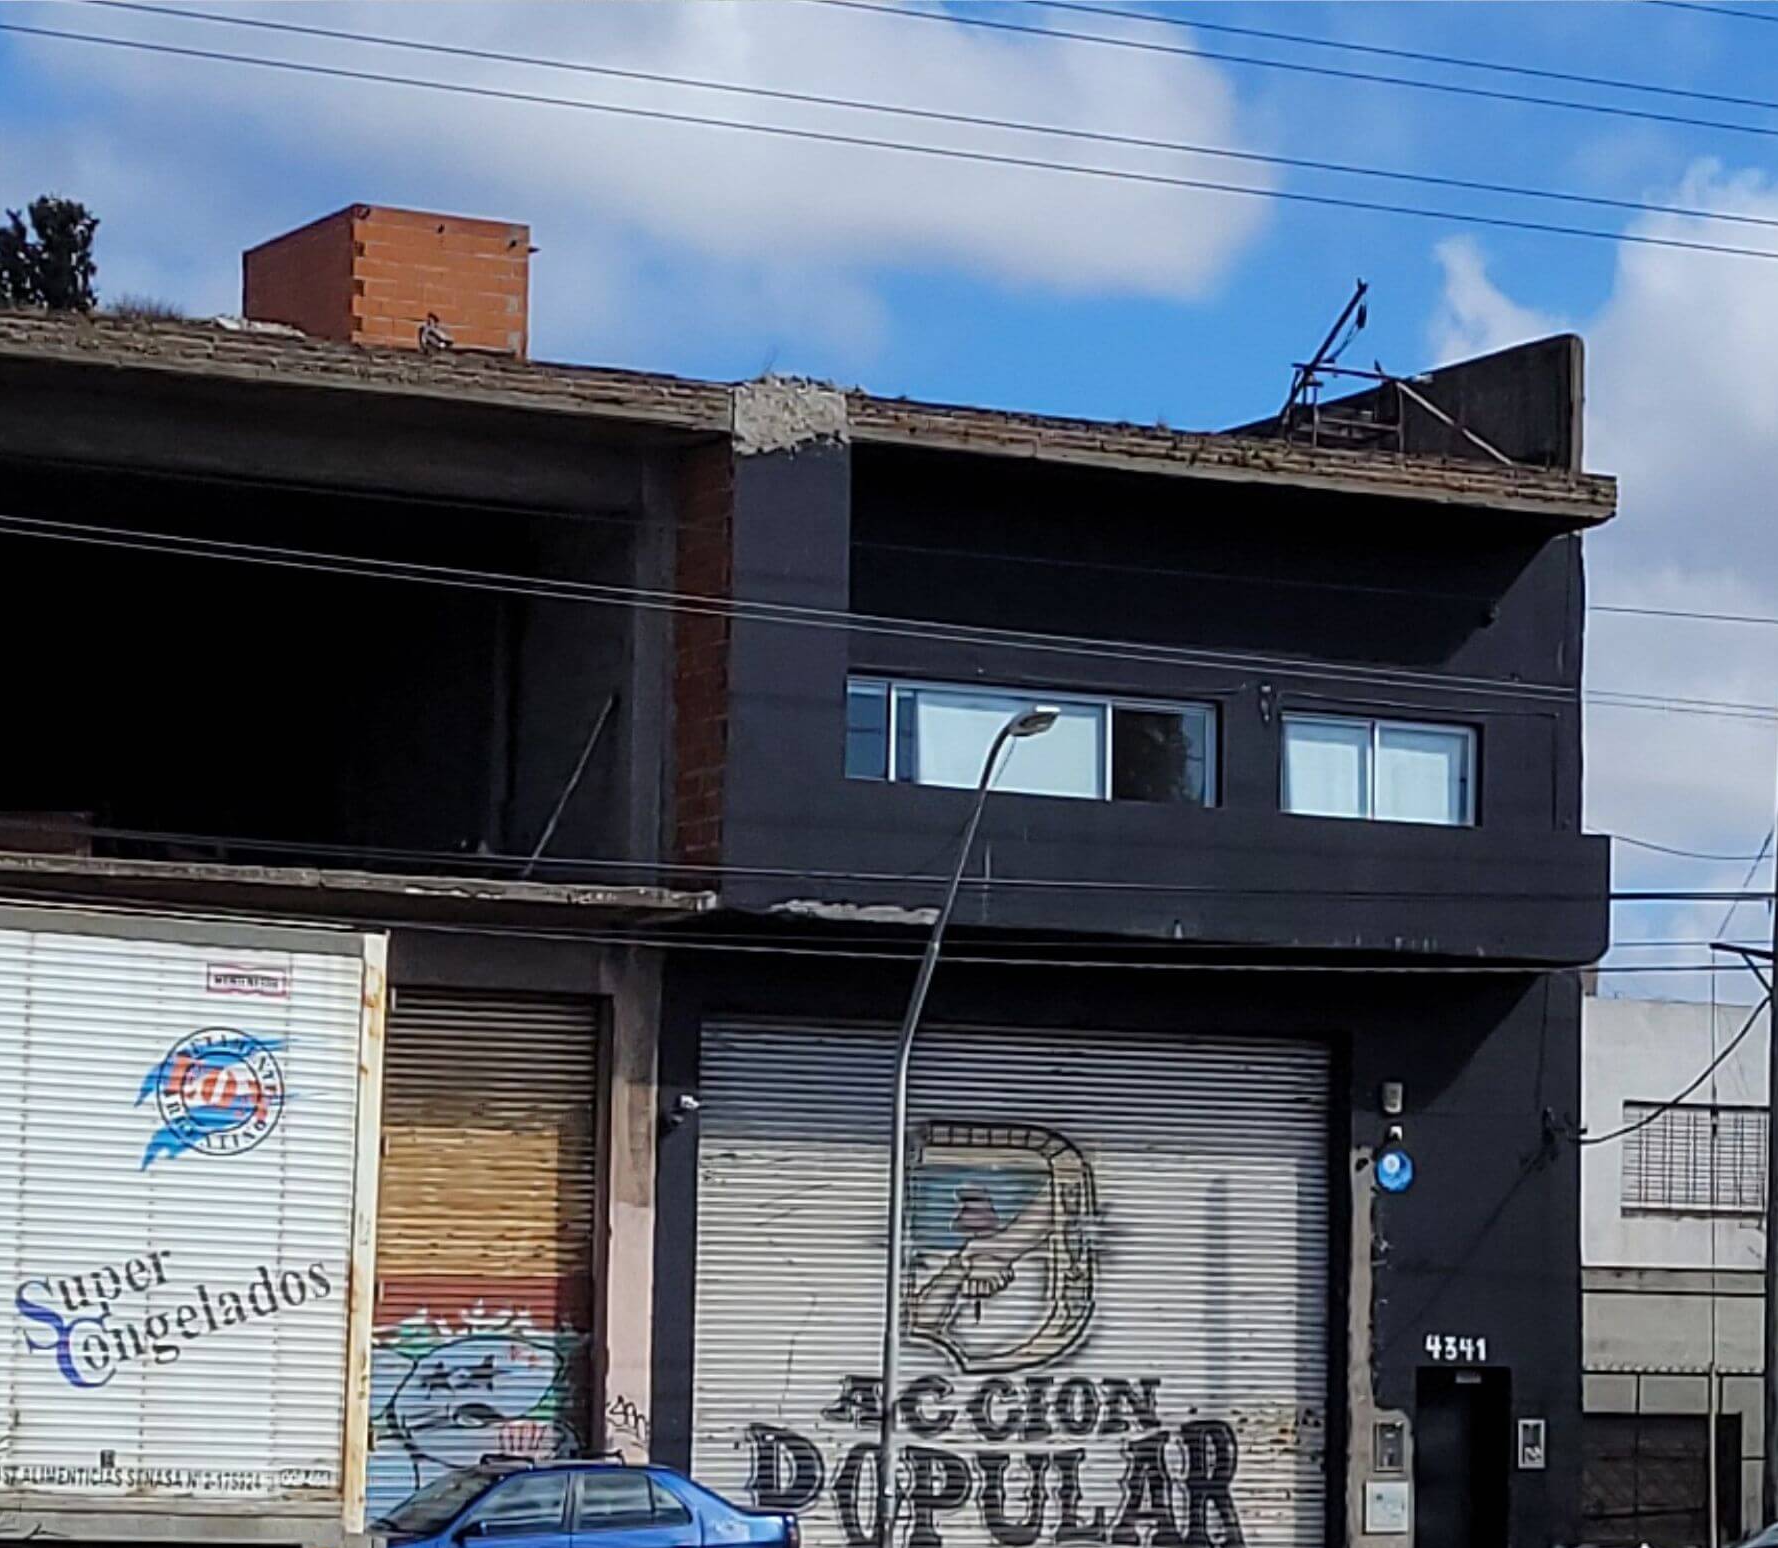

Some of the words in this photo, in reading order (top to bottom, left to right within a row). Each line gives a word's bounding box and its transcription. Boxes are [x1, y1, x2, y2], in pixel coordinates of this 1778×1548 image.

[16, 1250, 171, 1353] Super
[57, 1262, 331, 1388] Congelados
[1426, 1334, 1486, 1361] 4341
[822, 1374, 1162, 1441] ACCION
